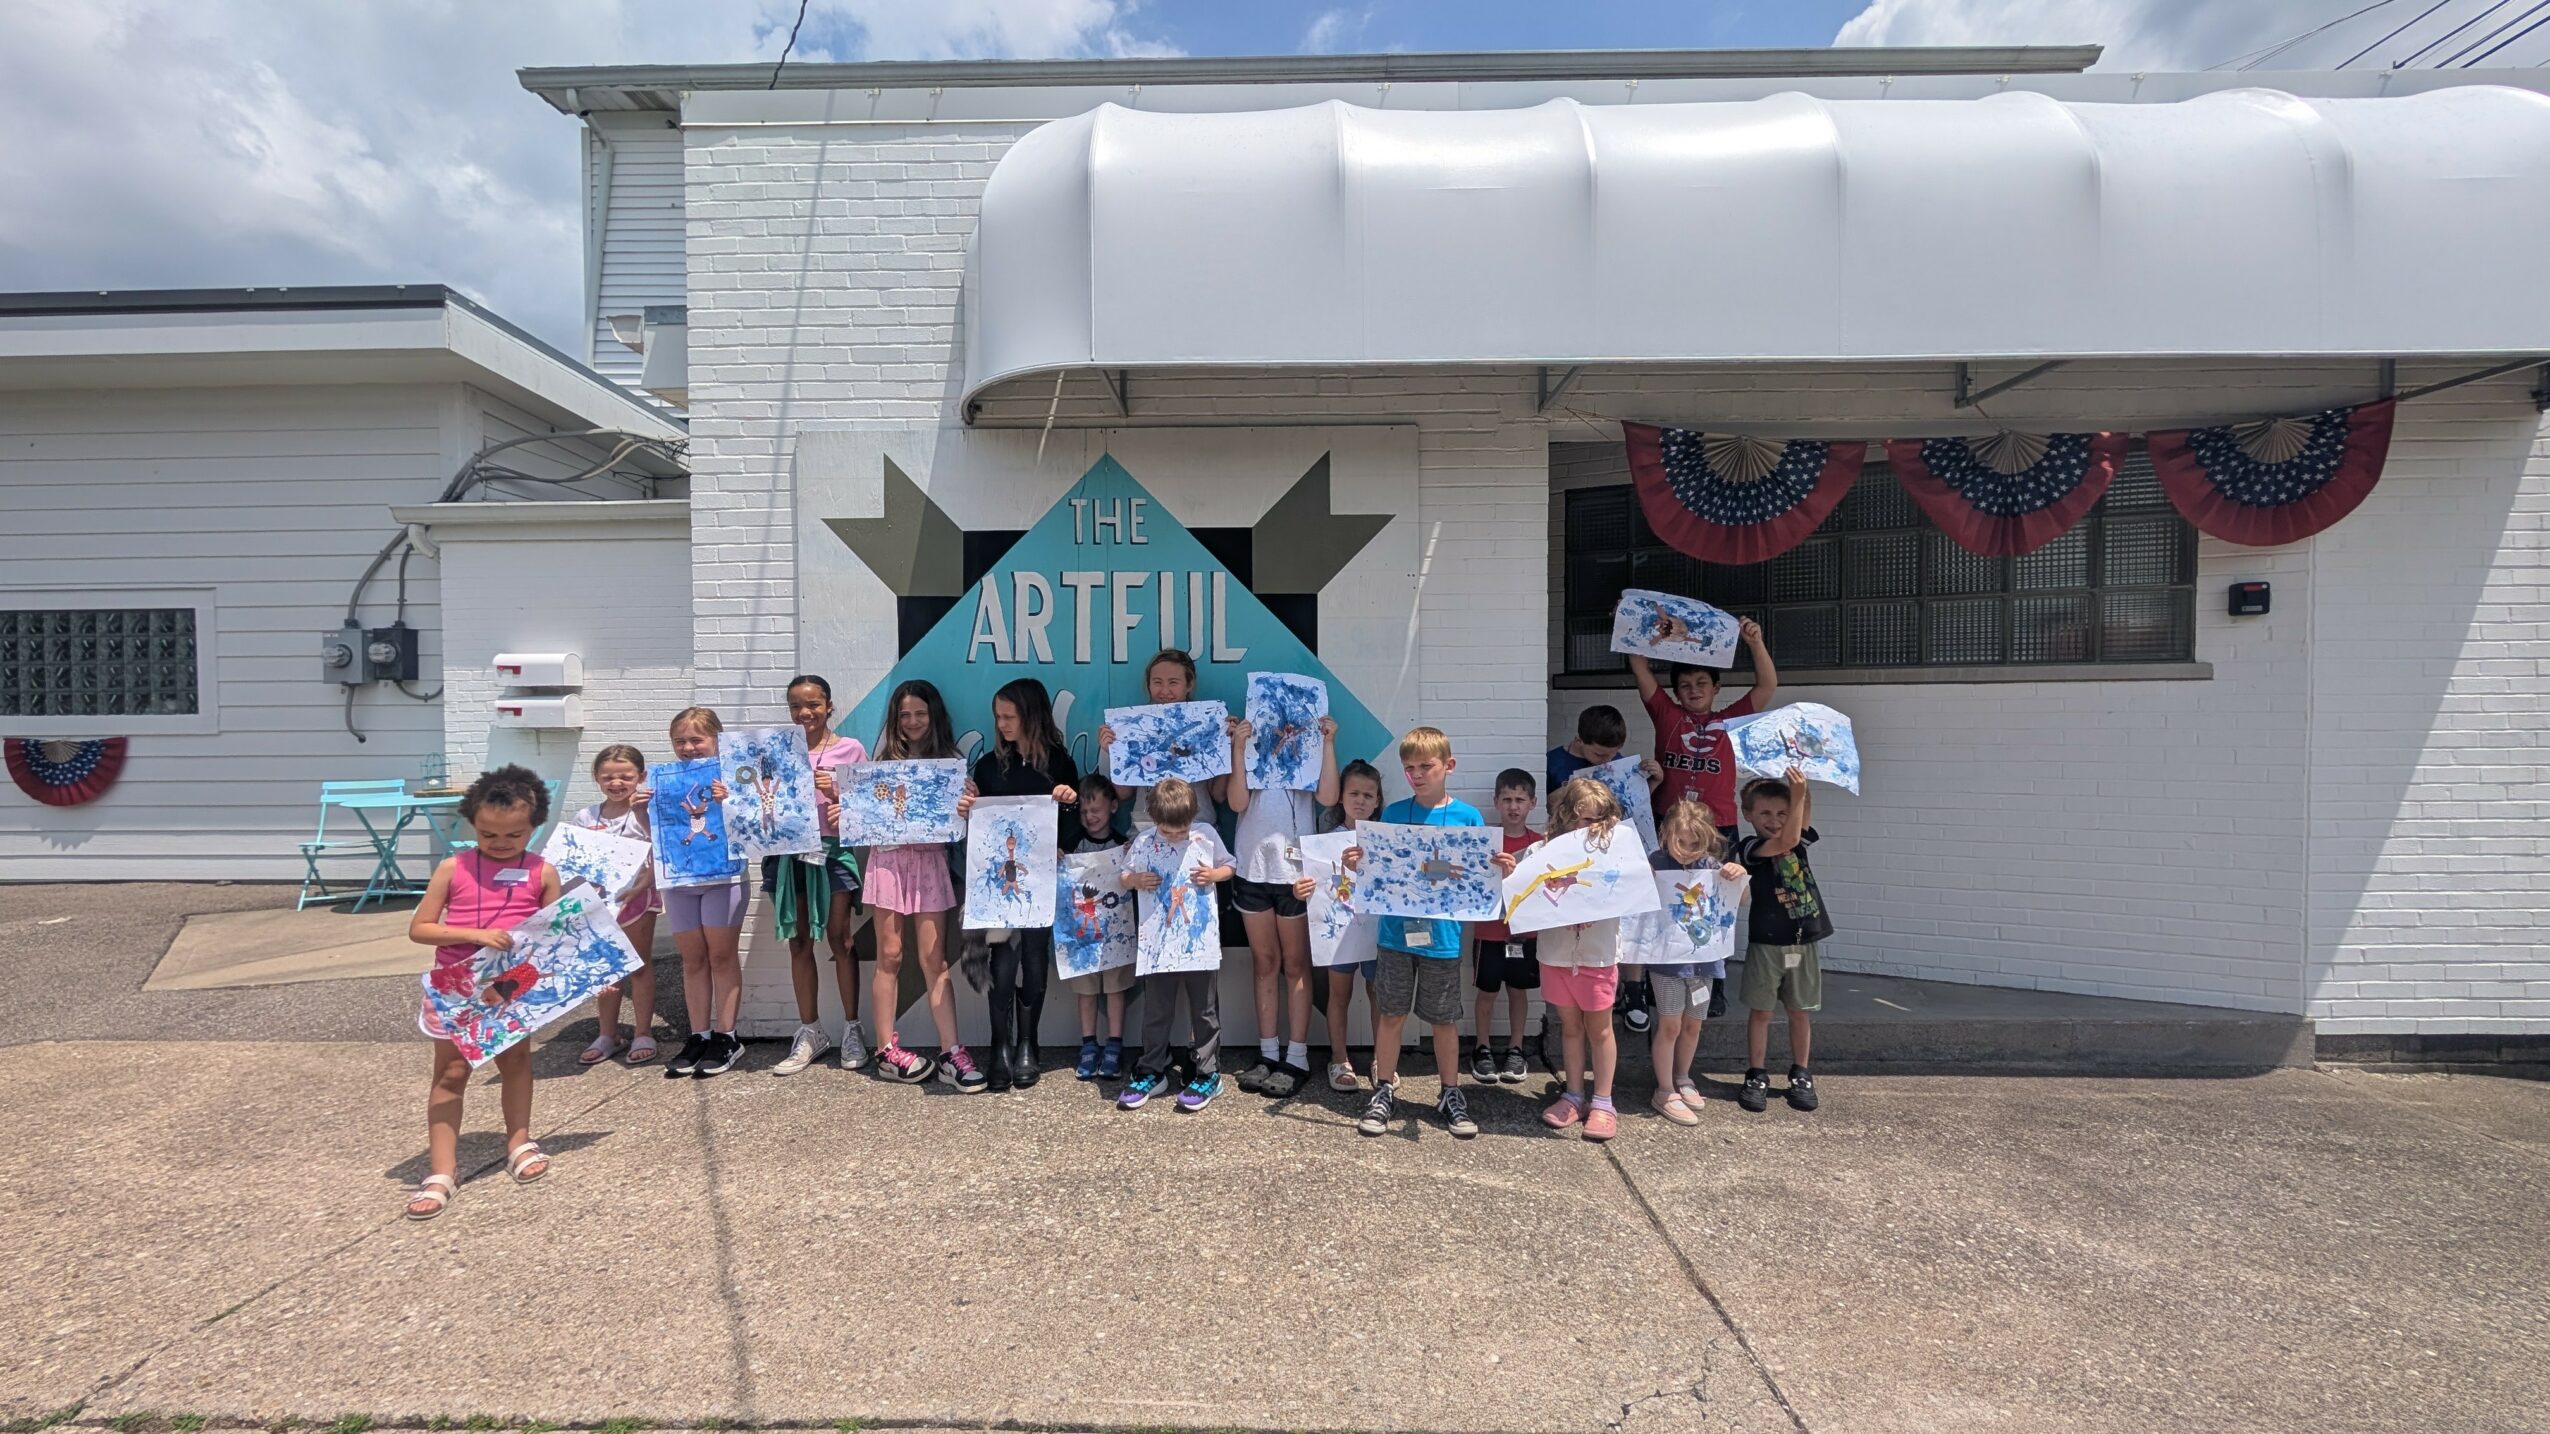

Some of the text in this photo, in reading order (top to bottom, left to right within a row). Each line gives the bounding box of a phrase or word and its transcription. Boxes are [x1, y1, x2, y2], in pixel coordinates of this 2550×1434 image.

[1068, 498, 1149, 545] THE
[966, 571, 1249, 664] ARTFUL
[1663, 752, 1721, 774] REDS
